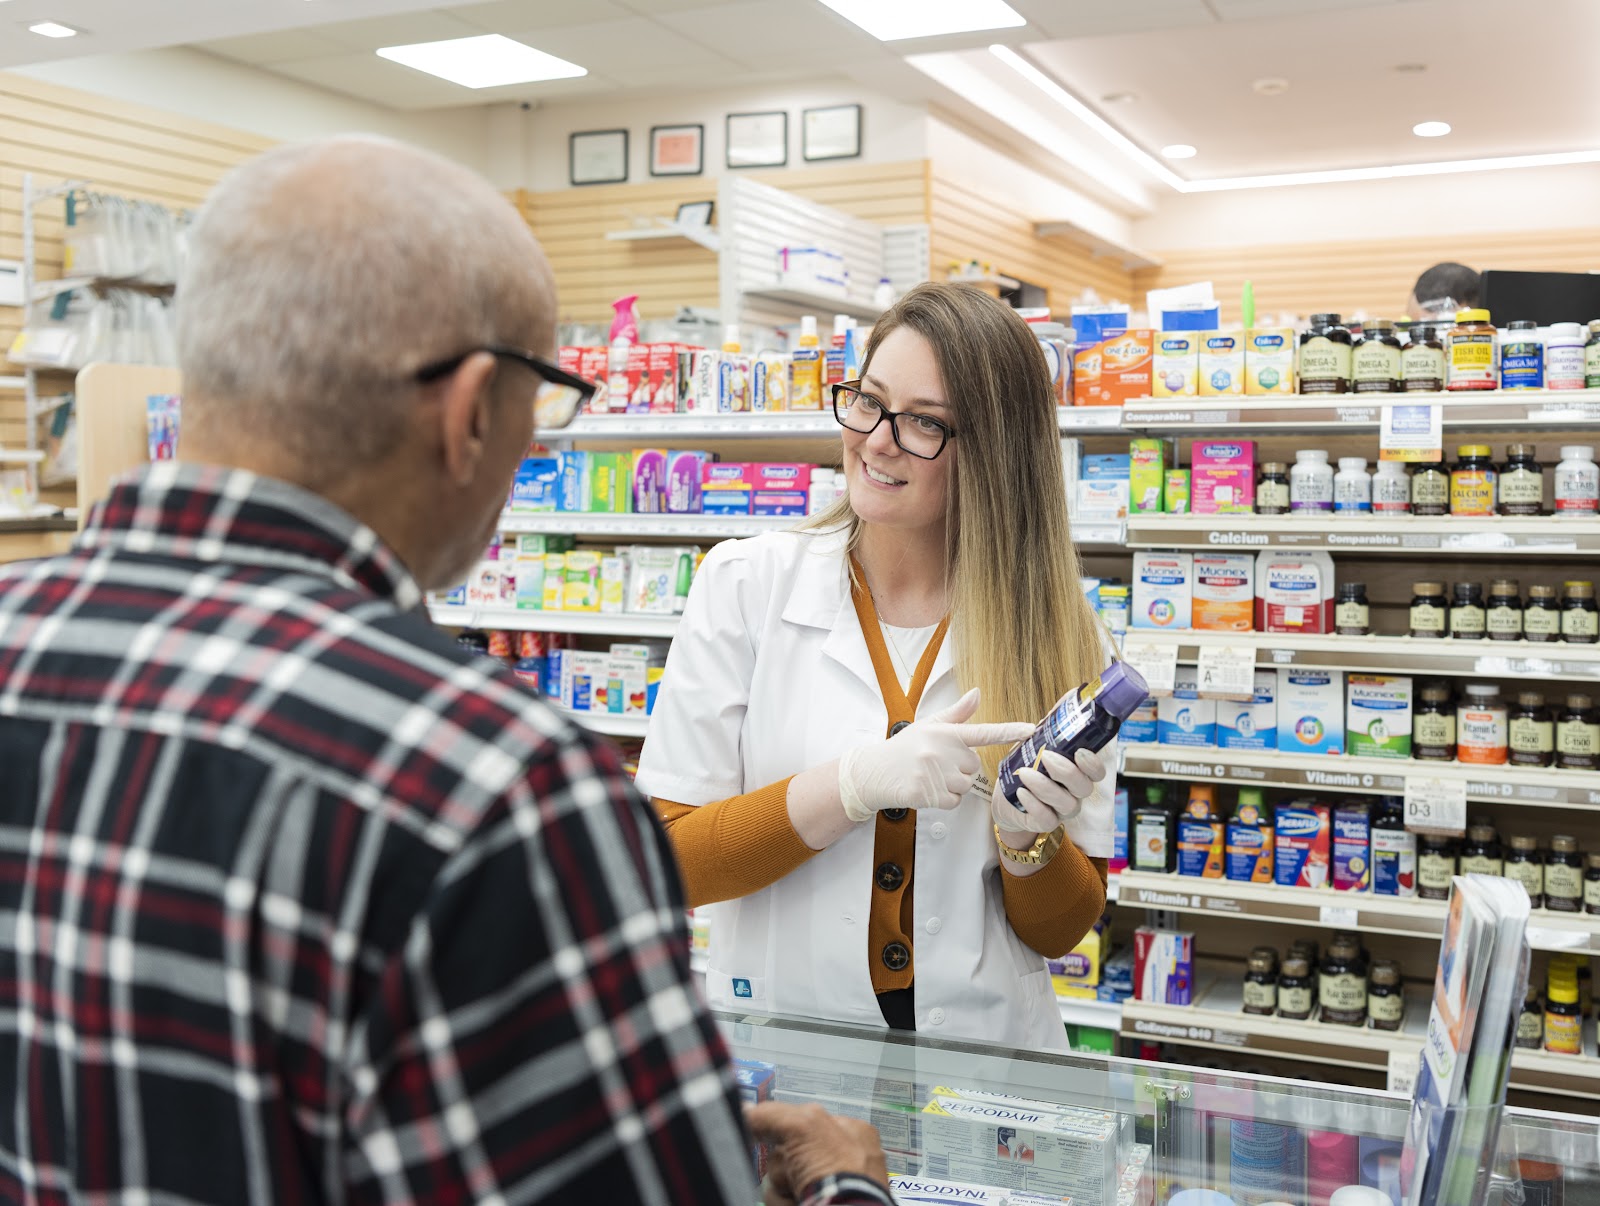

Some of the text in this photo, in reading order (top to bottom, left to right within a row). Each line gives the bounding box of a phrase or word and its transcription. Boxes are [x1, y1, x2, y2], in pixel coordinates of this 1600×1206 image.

[1454, 347, 1489, 356] FISH OIL
[1304, 358, 1337, 366] OMEGA-3
[1358, 360, 1390, 368] OMEGA-3
[1406, 360, 1436, 368] OMEGA-3
[1126, 412, 1191, 422] Comparables
[711, 468, 742, 477] Benadryl
[764, 468, 796, 478] Benadryl
[514, 484, 542, 494] Claritin
[1453, 490, 1489, 498] CALCIUM
[1209, 531, 1269, 545] Calcium
[1328, 534, 1399, 545] Comparables
[1200, 567, 1246, 577] Mucinex
[1271, 572, 1314, 580] Mucinex
[1204, 671, 1212, 682] A
[1354, 690, 1394, 698] Mucinex
[1422, 729, 1446, 737] C-1500
[1464, 722, 1496, 734] Vitamin C
[1162, 762, 1211, 776] Vitamin
[1214, 764, 1225, 776] C
[976, 774, 988, 785] Julia
[1306, 771, 1373, 786] Vitamin C
[1409, 803, 1431, 817] D-3
[1335, 820, 1367, 831] Diabetic
[1344, 830, 1367, 838] Tussin
[1138, 891, 1188, 906] Vitamin
[1192, 896, 1201, 908] E
[1135, 1020, 1188, 1037] CoEnzyme
[1189, 1027, 1212, 1040] Q10
[888, 1179, 990, 1200] ENSODYNE
